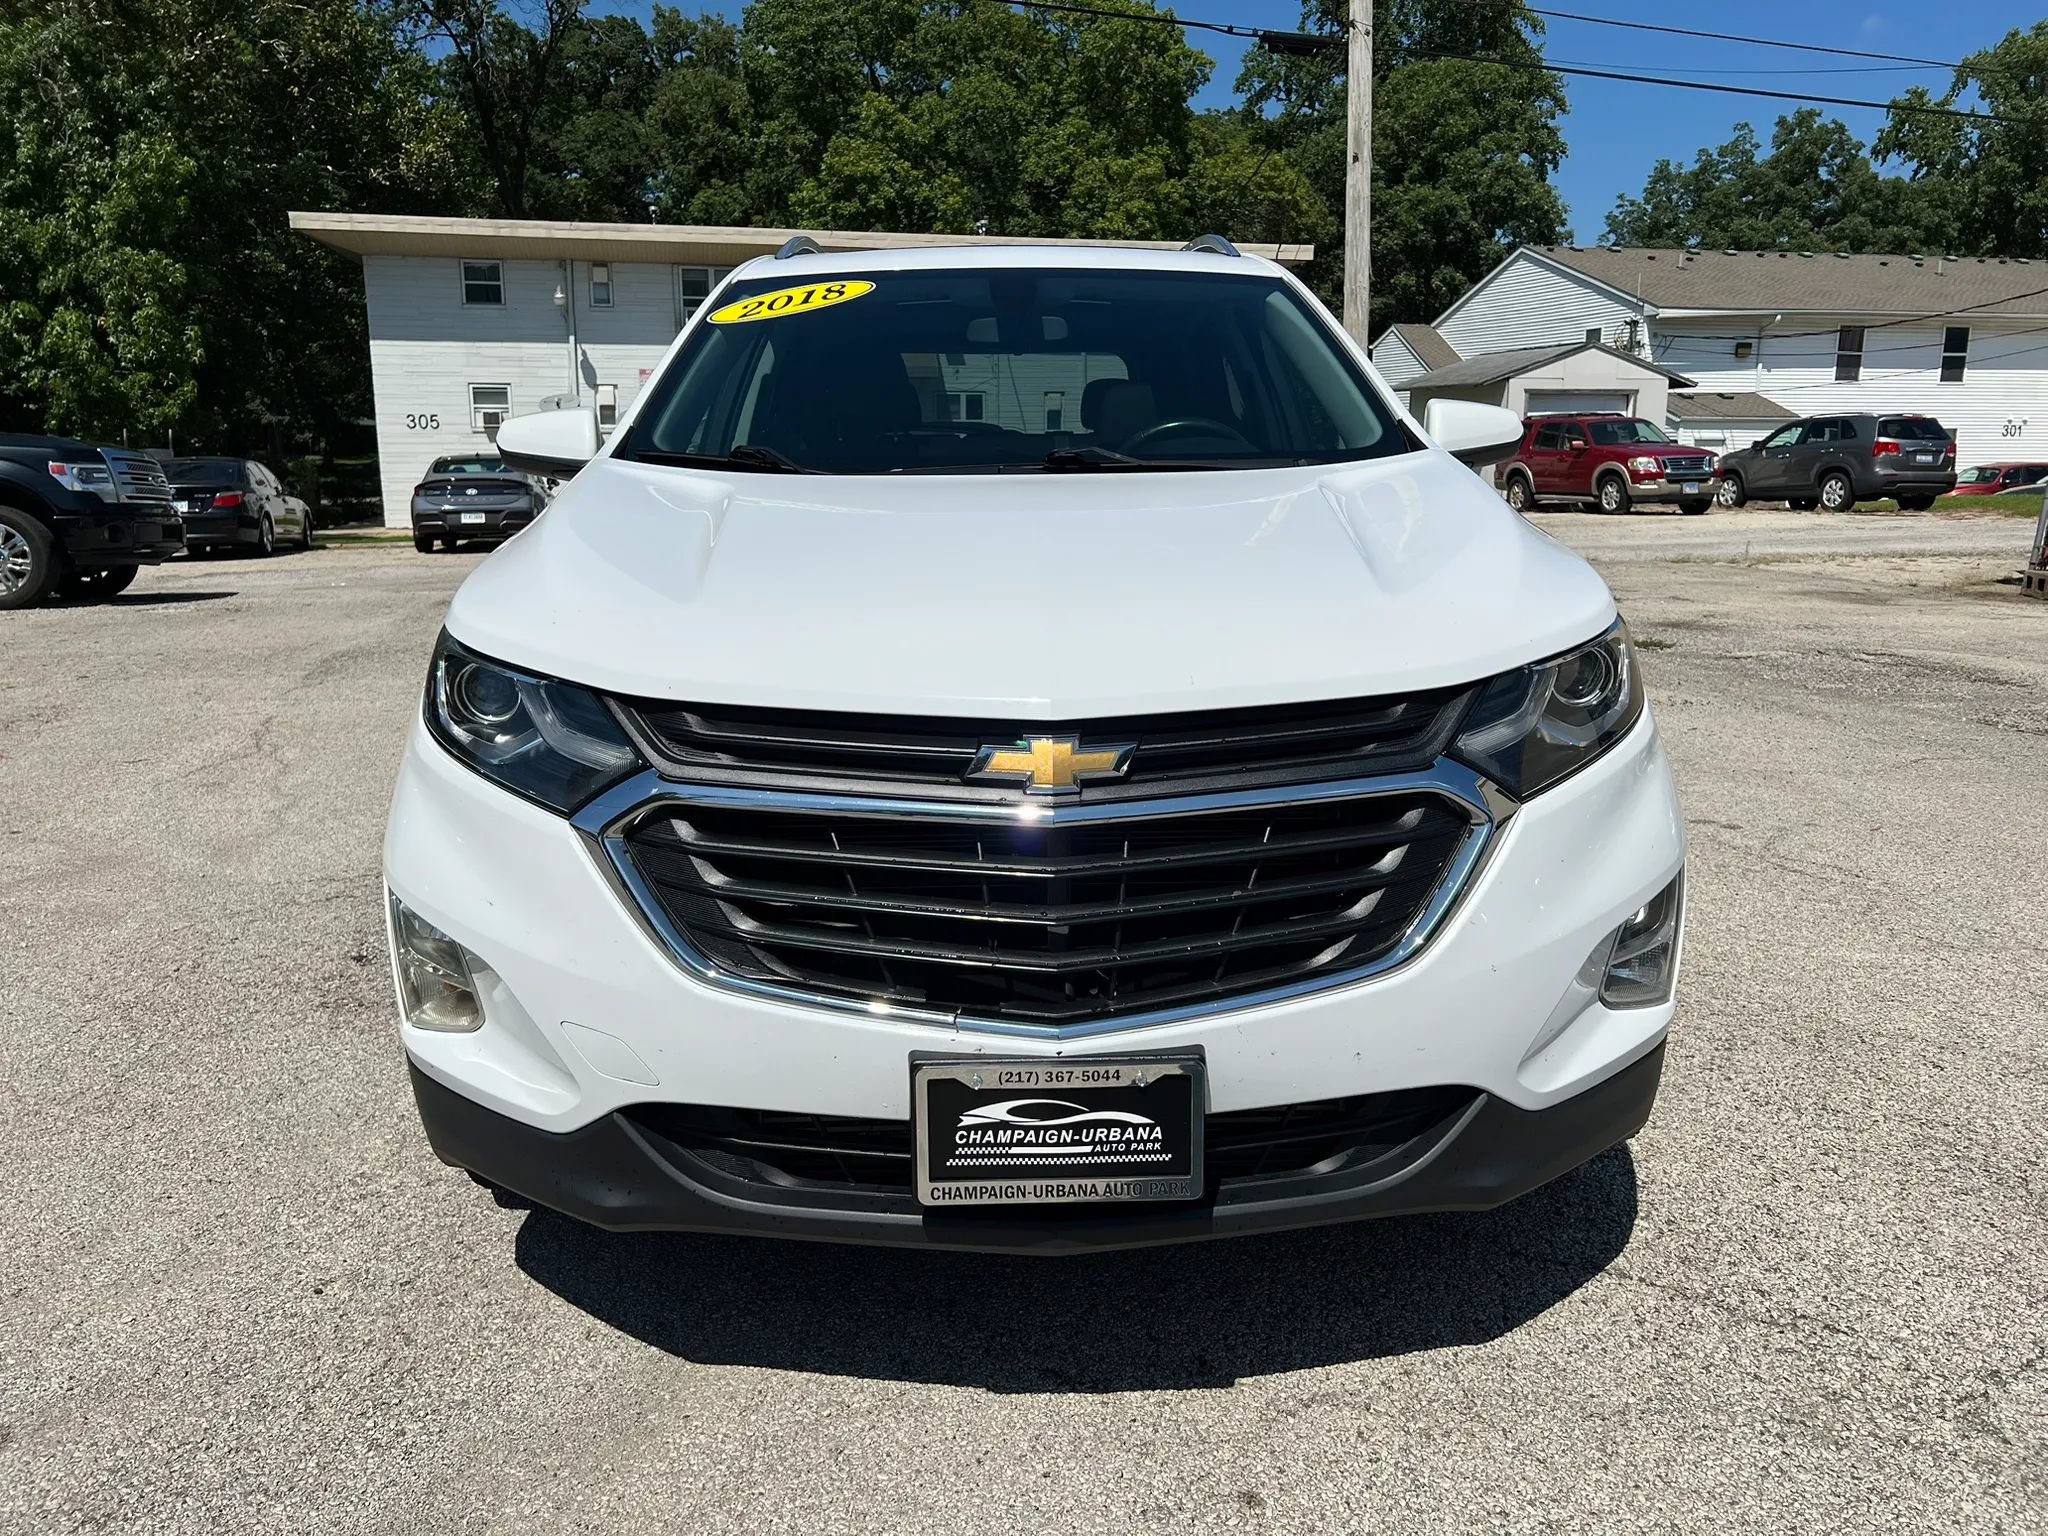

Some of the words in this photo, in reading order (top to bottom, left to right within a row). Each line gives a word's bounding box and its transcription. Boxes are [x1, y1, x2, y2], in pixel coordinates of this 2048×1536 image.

[737, 284, 847, 320] 2018
[406, 413, 440, 430] 305
[2001, 424, 2022, 437] 301
[997, 1070, 1040, 1086] (217)
[1044, 1069, 1121, 1084] 367-5044
[955, 1126, 1163, 1144] CHAMPAIGN-URBANA
[1094, 1143, 1126, 1152] AUTO
[1130, 1142, 1162, 1151] PARK
[930, 1183, 1099, 1201] CHAMPAIGN-URBANA
[1102, 1182, 1143, 1197] AUTO
[1149, 1181, 1191, 1196] PARK
